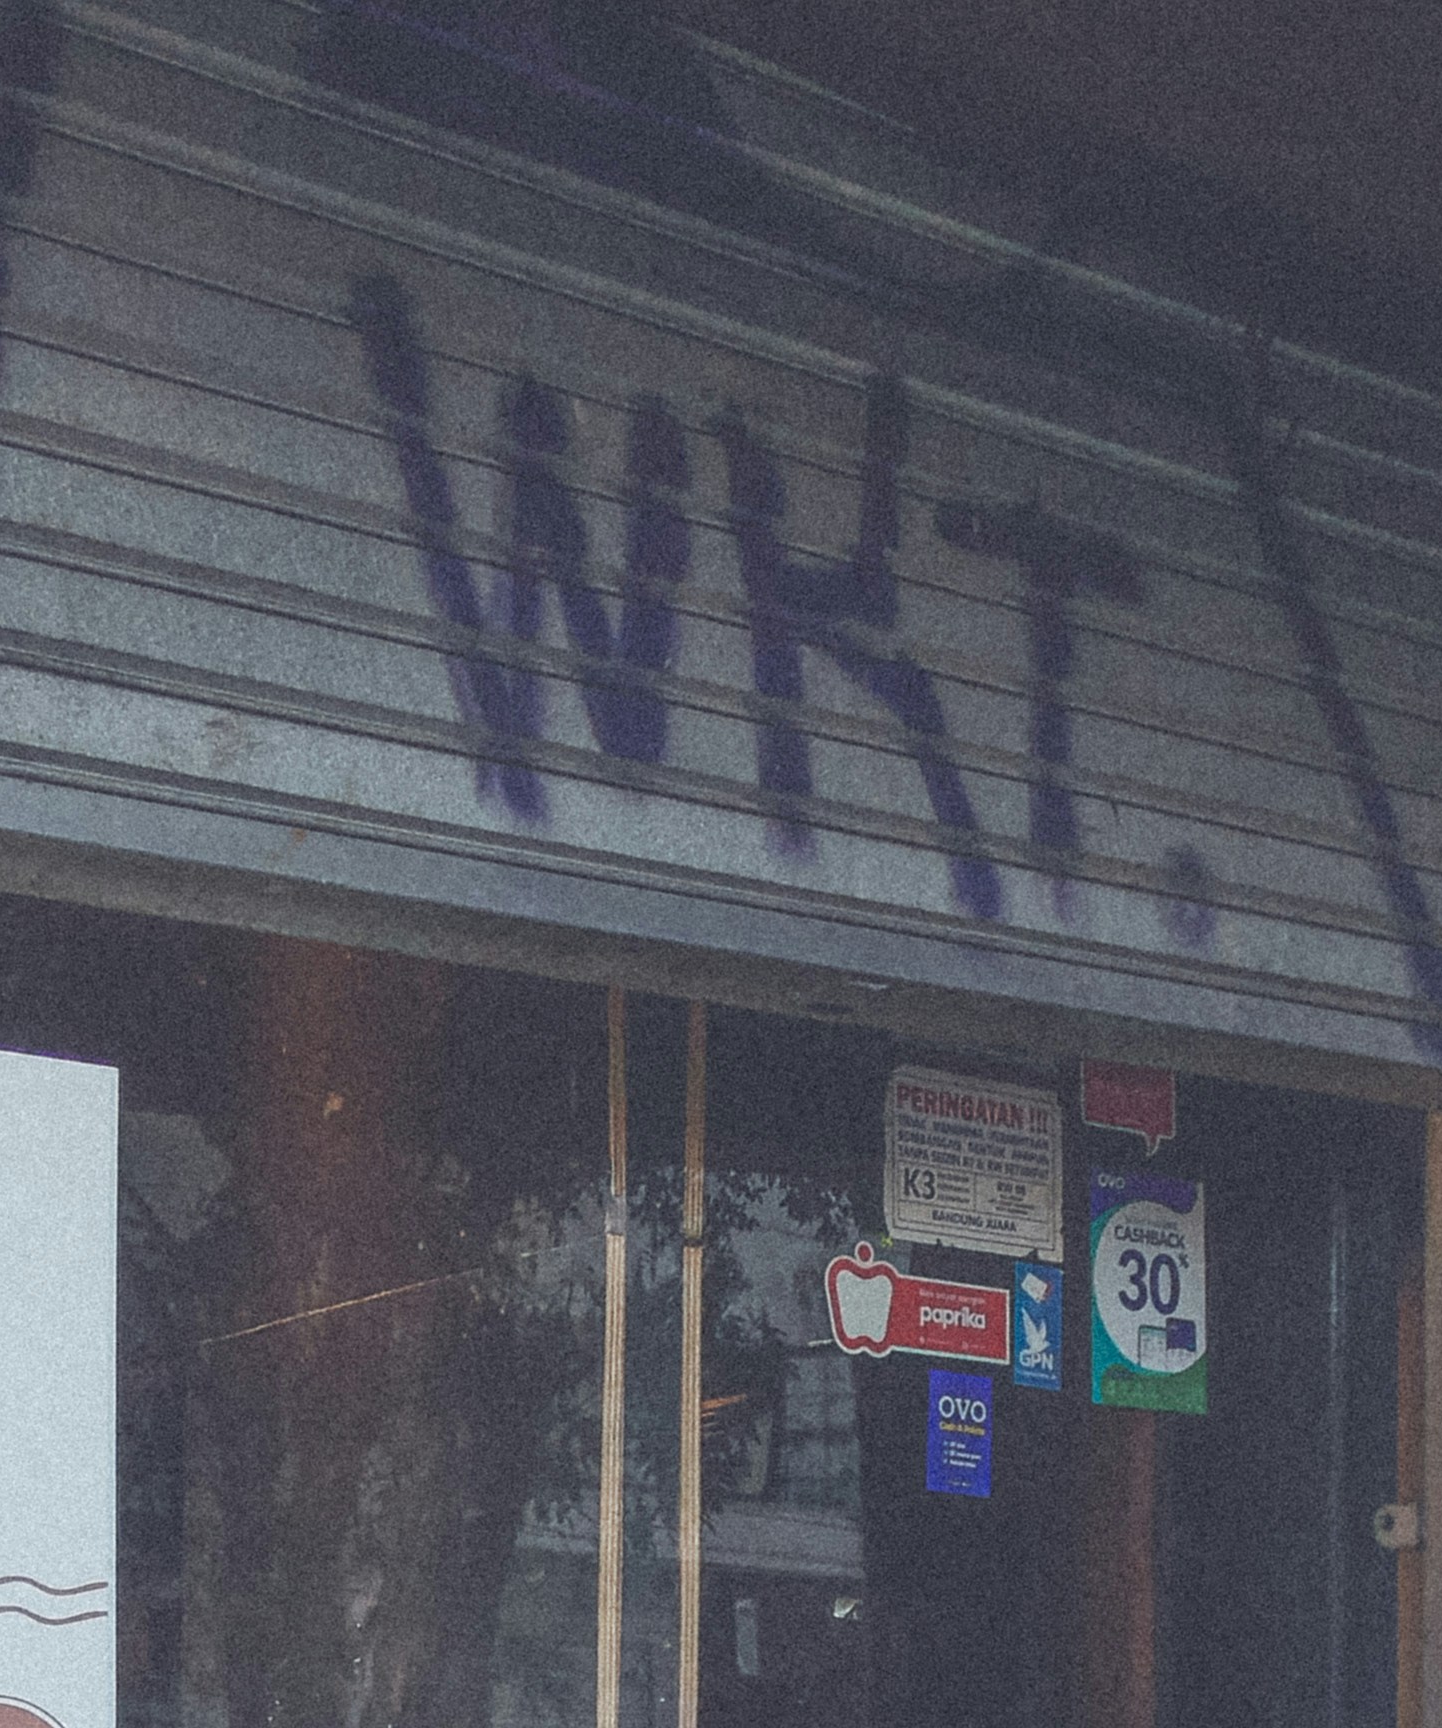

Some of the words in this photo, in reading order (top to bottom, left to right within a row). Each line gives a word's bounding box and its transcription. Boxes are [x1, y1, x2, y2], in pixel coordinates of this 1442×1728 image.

[896, 1082, 1025, 1129] PERINGATAN
[903, 1167, 936, 1200] K3
[1098, 1173, 1126, 1189] OVO
[931, 1209, 983, 1228] BANDUNG
[1114, 1224, 1186, 1249] CASHBACK
[919, 1306, 986, 1330] paprika
[1019, 1350, 1054, 1371] GPN
[938, 1395, 987, 1422] OVO
